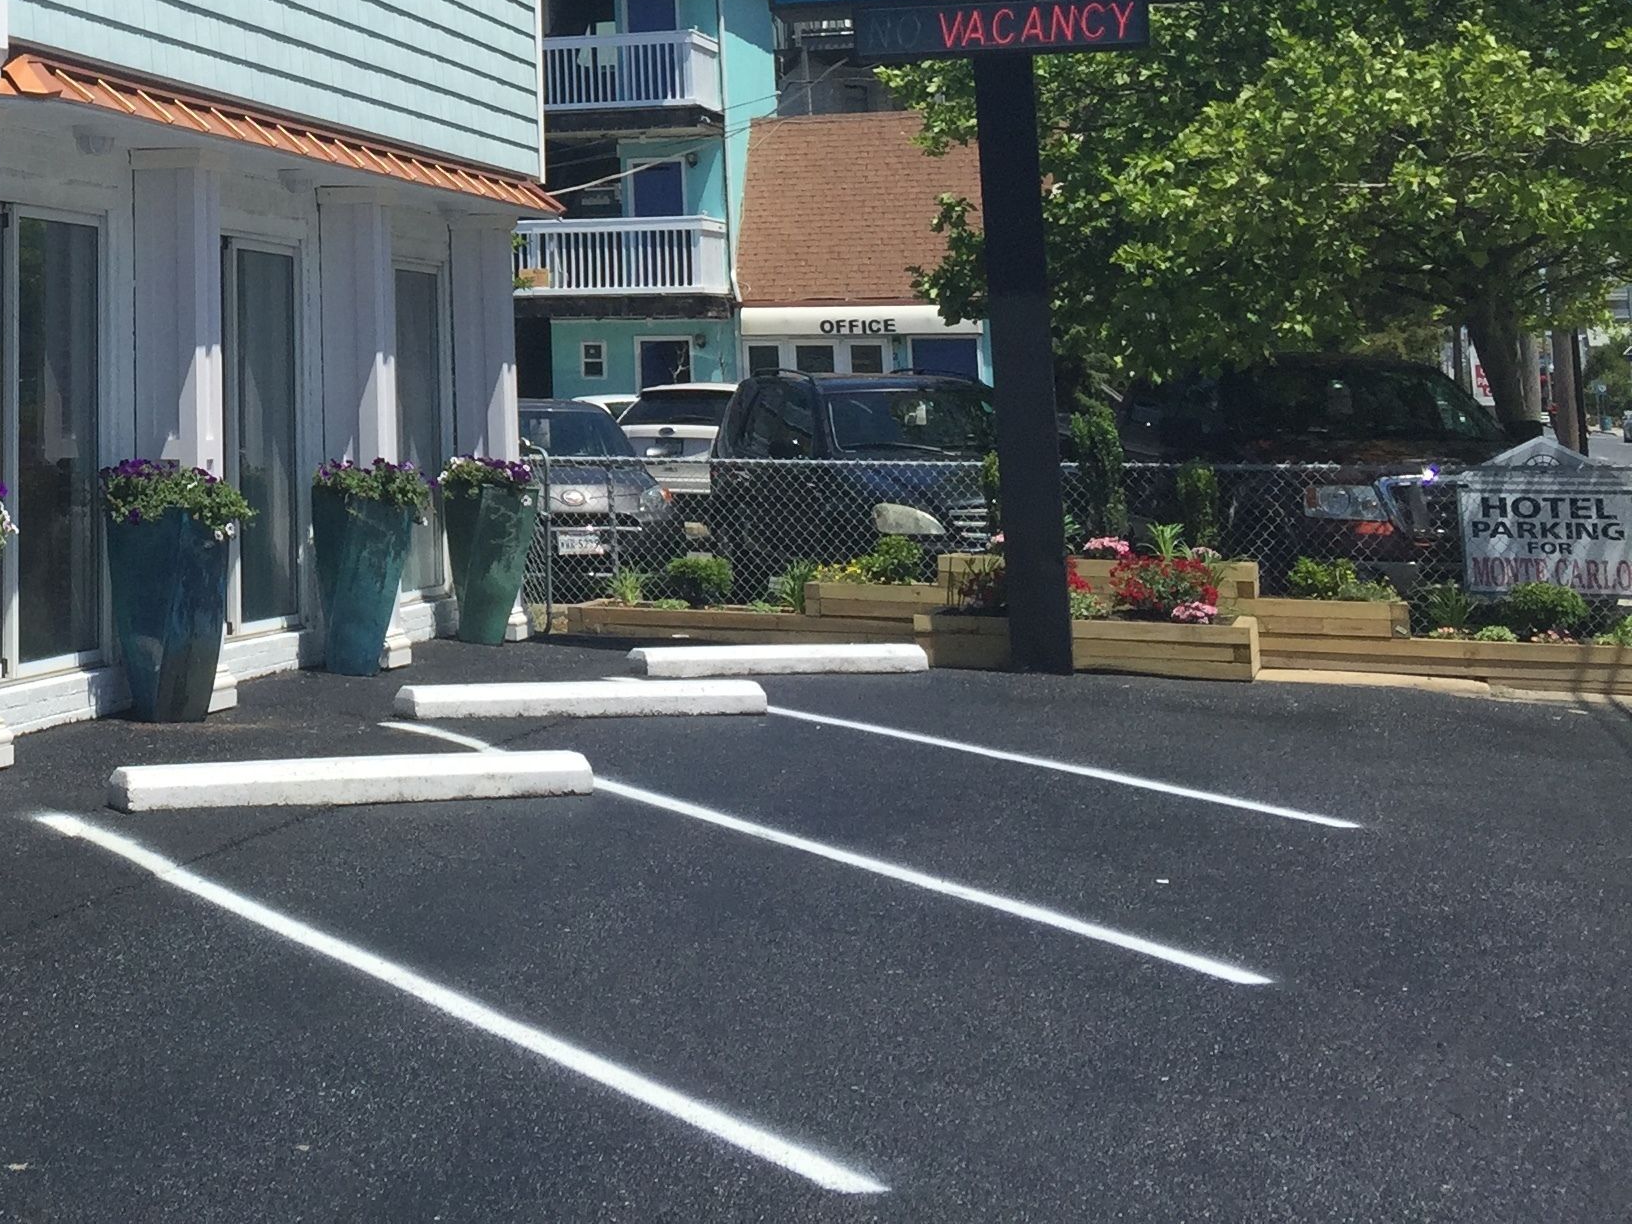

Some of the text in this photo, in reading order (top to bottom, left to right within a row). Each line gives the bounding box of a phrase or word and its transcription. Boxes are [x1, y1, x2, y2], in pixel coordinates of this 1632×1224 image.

[938, 1, 1134, 49] VACANCY
[820, 318, 897, 335] OFFICE
[1480, 496, 1618, 521] HOTEL
[1471, 521, 1625, 541] PARKING
[1527, 541, 1573, 555] FOR
[1471, 556, 1632, 591] MONTE CARLO
